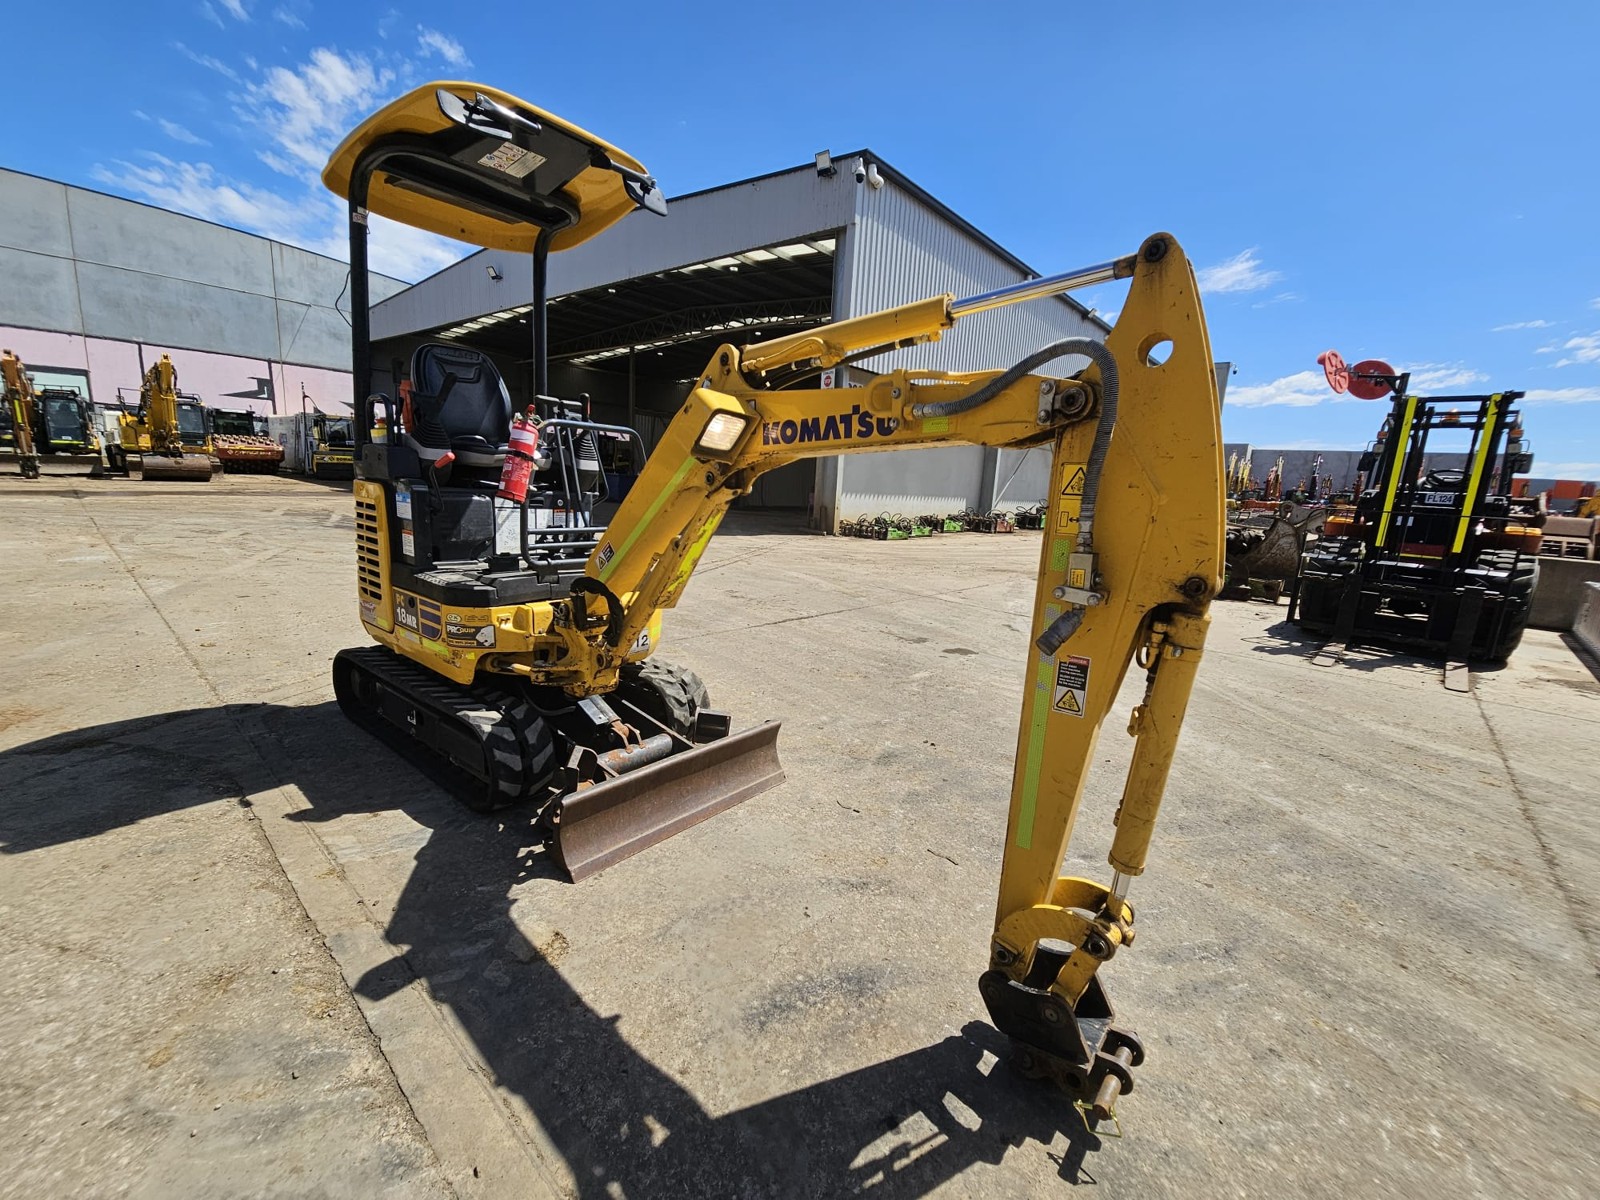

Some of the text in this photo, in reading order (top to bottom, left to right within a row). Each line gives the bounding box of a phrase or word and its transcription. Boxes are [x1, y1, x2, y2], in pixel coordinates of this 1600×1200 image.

[762, 405, 896, 446] KOMATSU
[1426, 494, 1453, 503] FL124
[396, 594, 405, 606] PC
